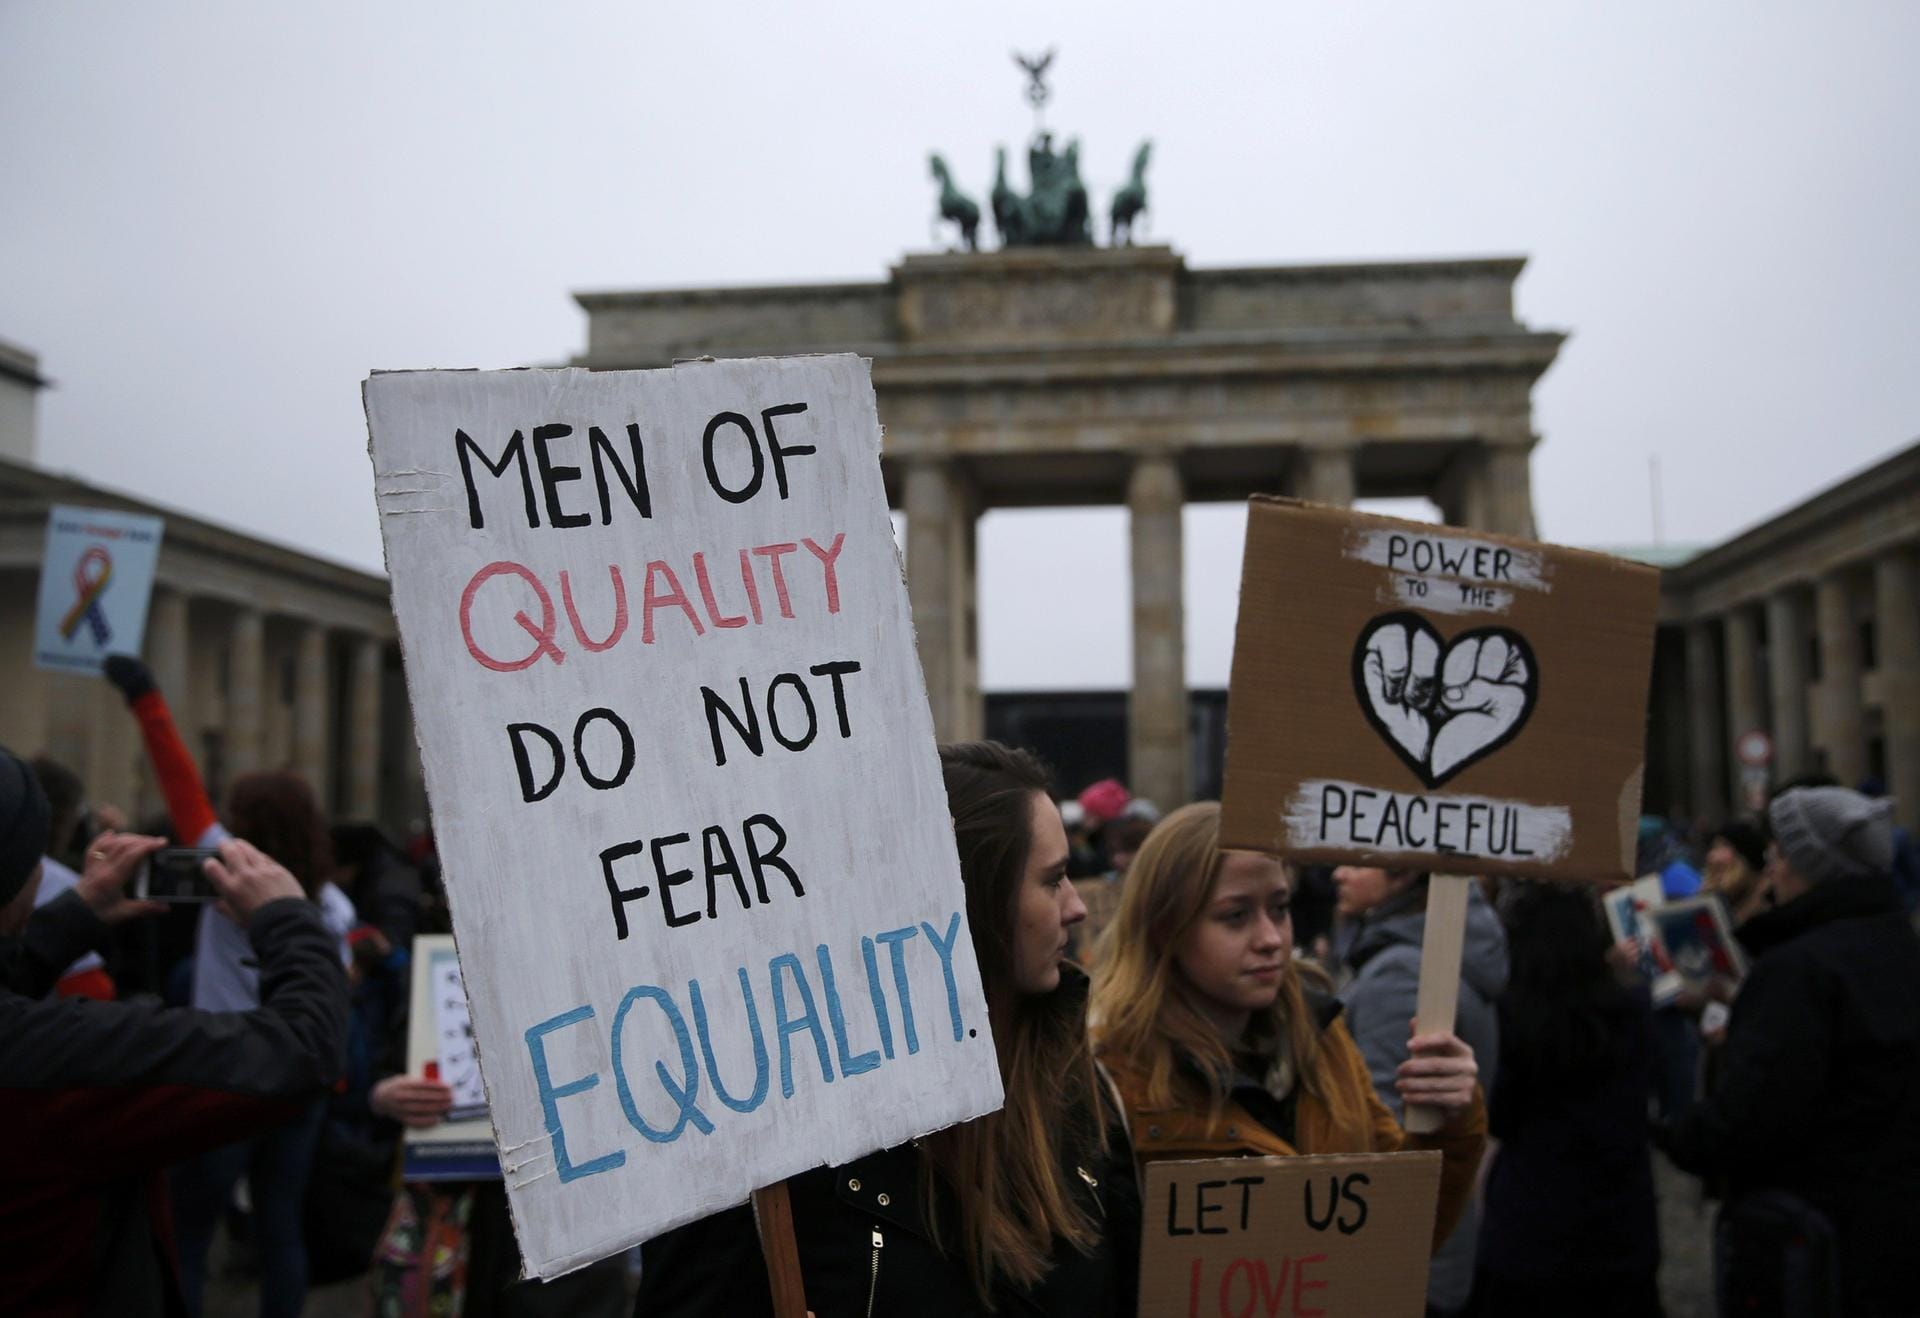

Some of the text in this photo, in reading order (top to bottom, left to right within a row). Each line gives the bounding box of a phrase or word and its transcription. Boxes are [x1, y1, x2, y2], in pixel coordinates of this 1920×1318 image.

[455, 403, 816, 529] MEN OF
[459, 533, 845, 672] QUALITY
[1388, 535, 1512, 580] POWER
[1405, 579, 1496, 607] TO THE
[507, 661, 861, 803] DO NOT
[599, 813, 805, 940] FEAR
[1319, 785, 1534, 855] PEACEFUL
[525, 911, 977, 1183] EQUALITY.
[1168, 1173, 1371, 1236] LET US
